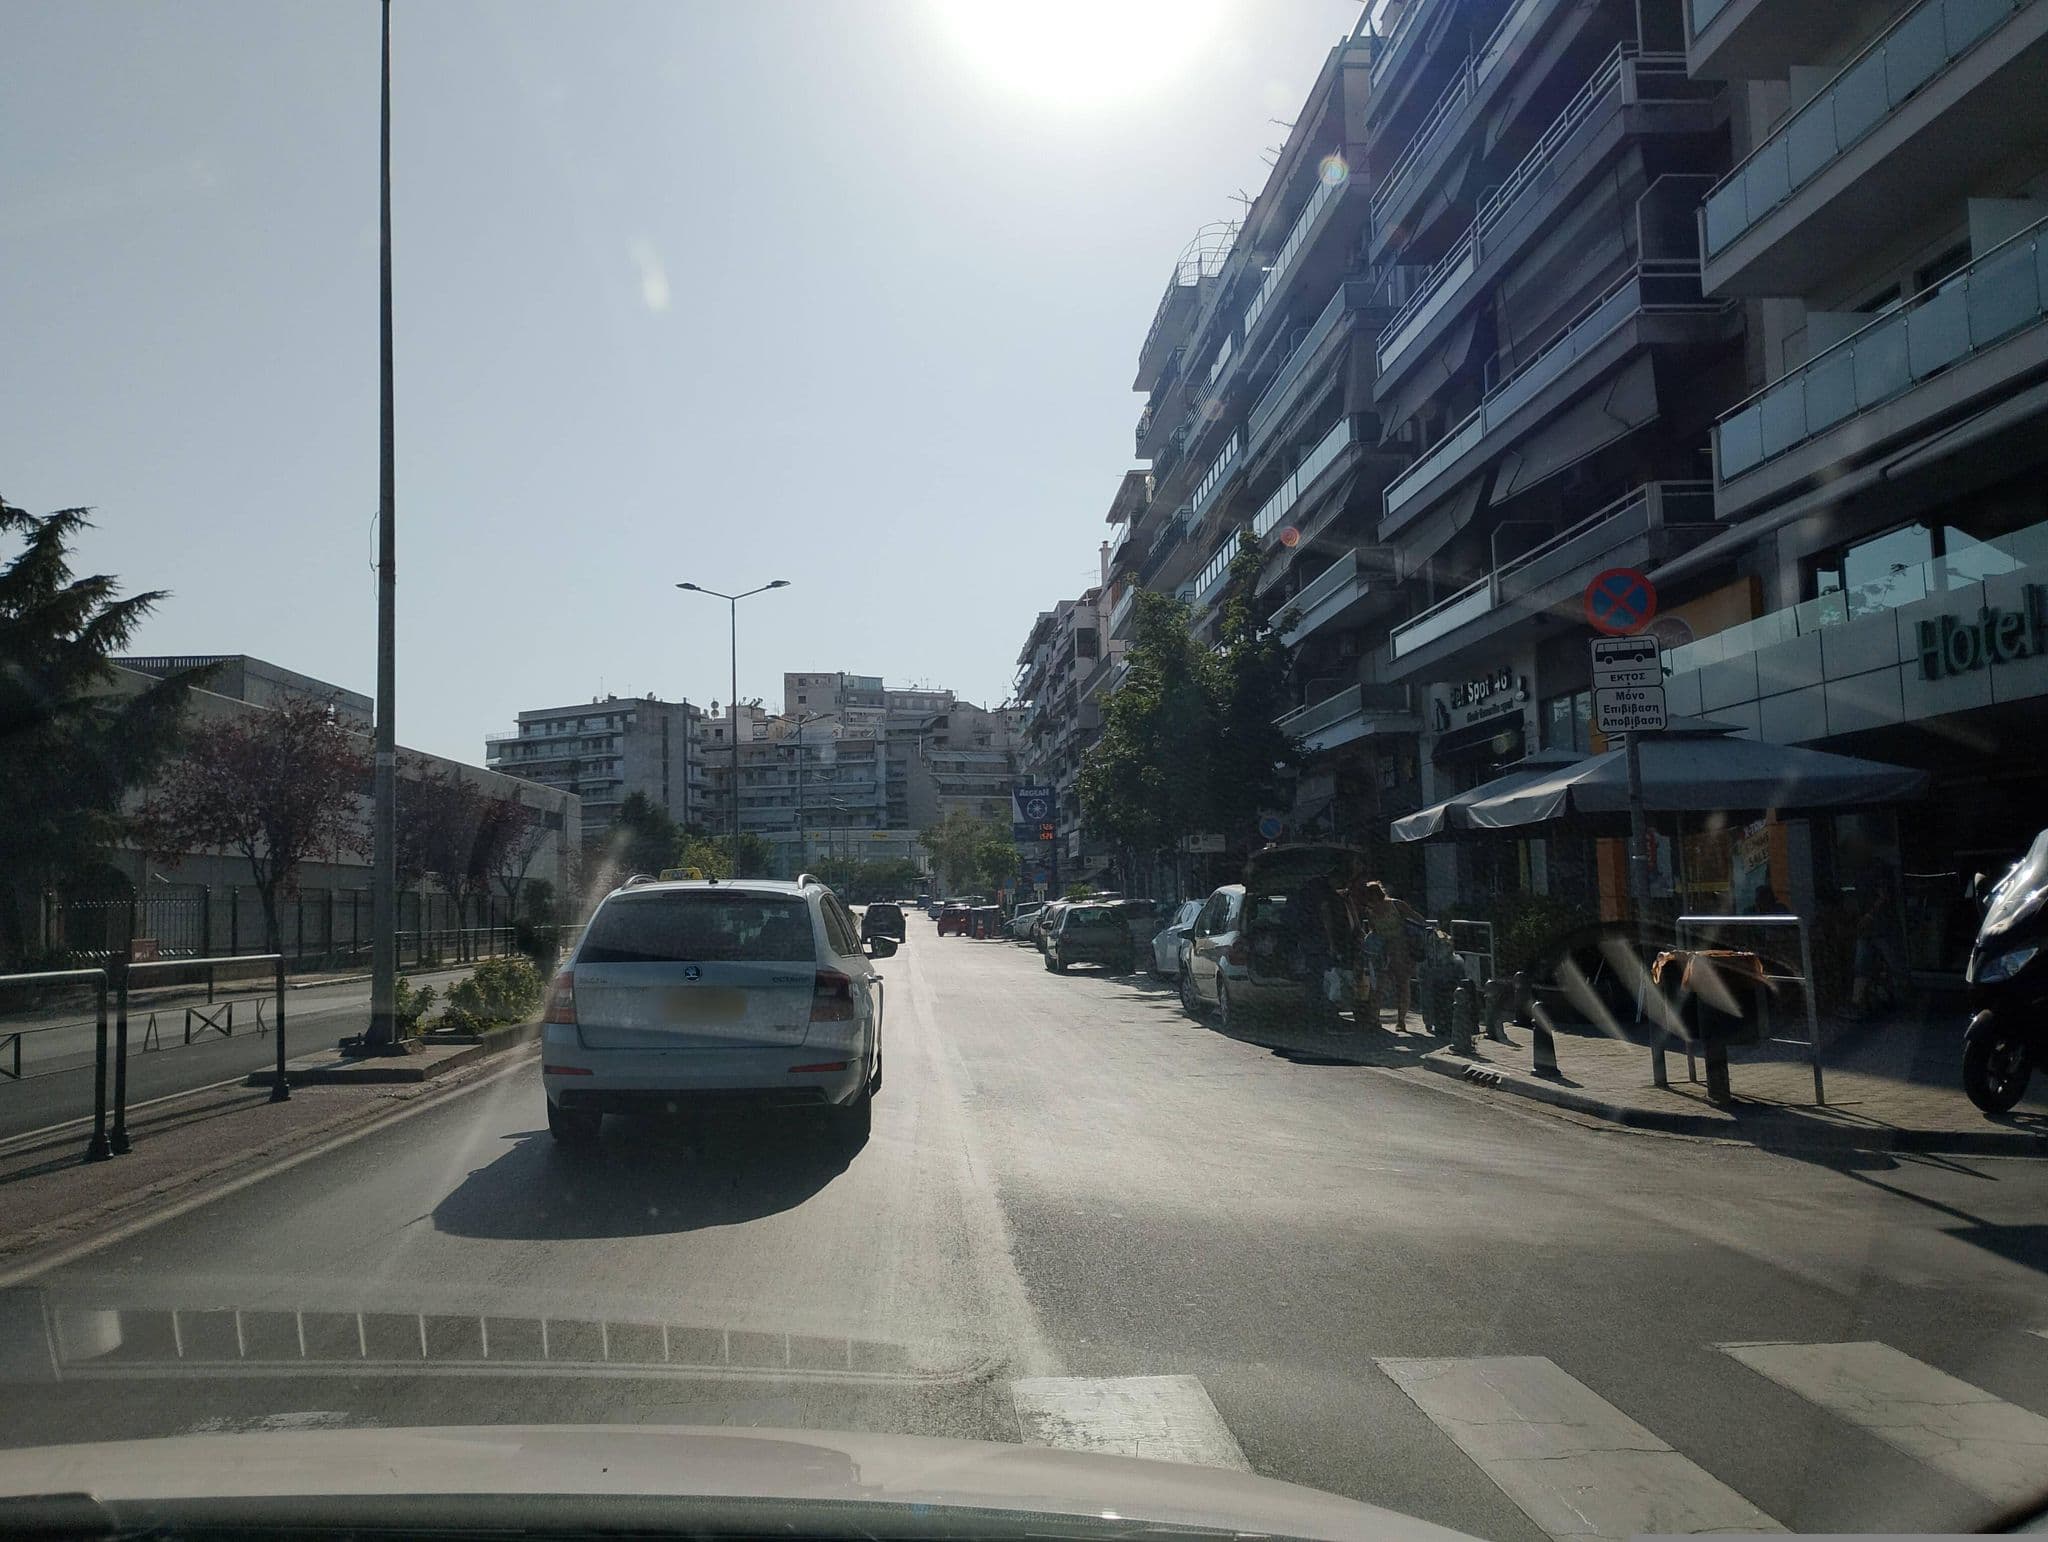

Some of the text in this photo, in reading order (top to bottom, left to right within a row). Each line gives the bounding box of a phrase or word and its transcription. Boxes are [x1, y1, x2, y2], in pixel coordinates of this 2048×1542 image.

[1914, 583, 2042, 681] Hotel
[1610, 672, 1646, 682] ΕΚΤΟΣ
[1467, 679, 1490, 705] Spot
[1616, 690, 1645, 701] Μόνο
[1603, 704, 1659, 715] Επιβίβαση
[1603, 716, 1662, 727] Αποβίβαση
